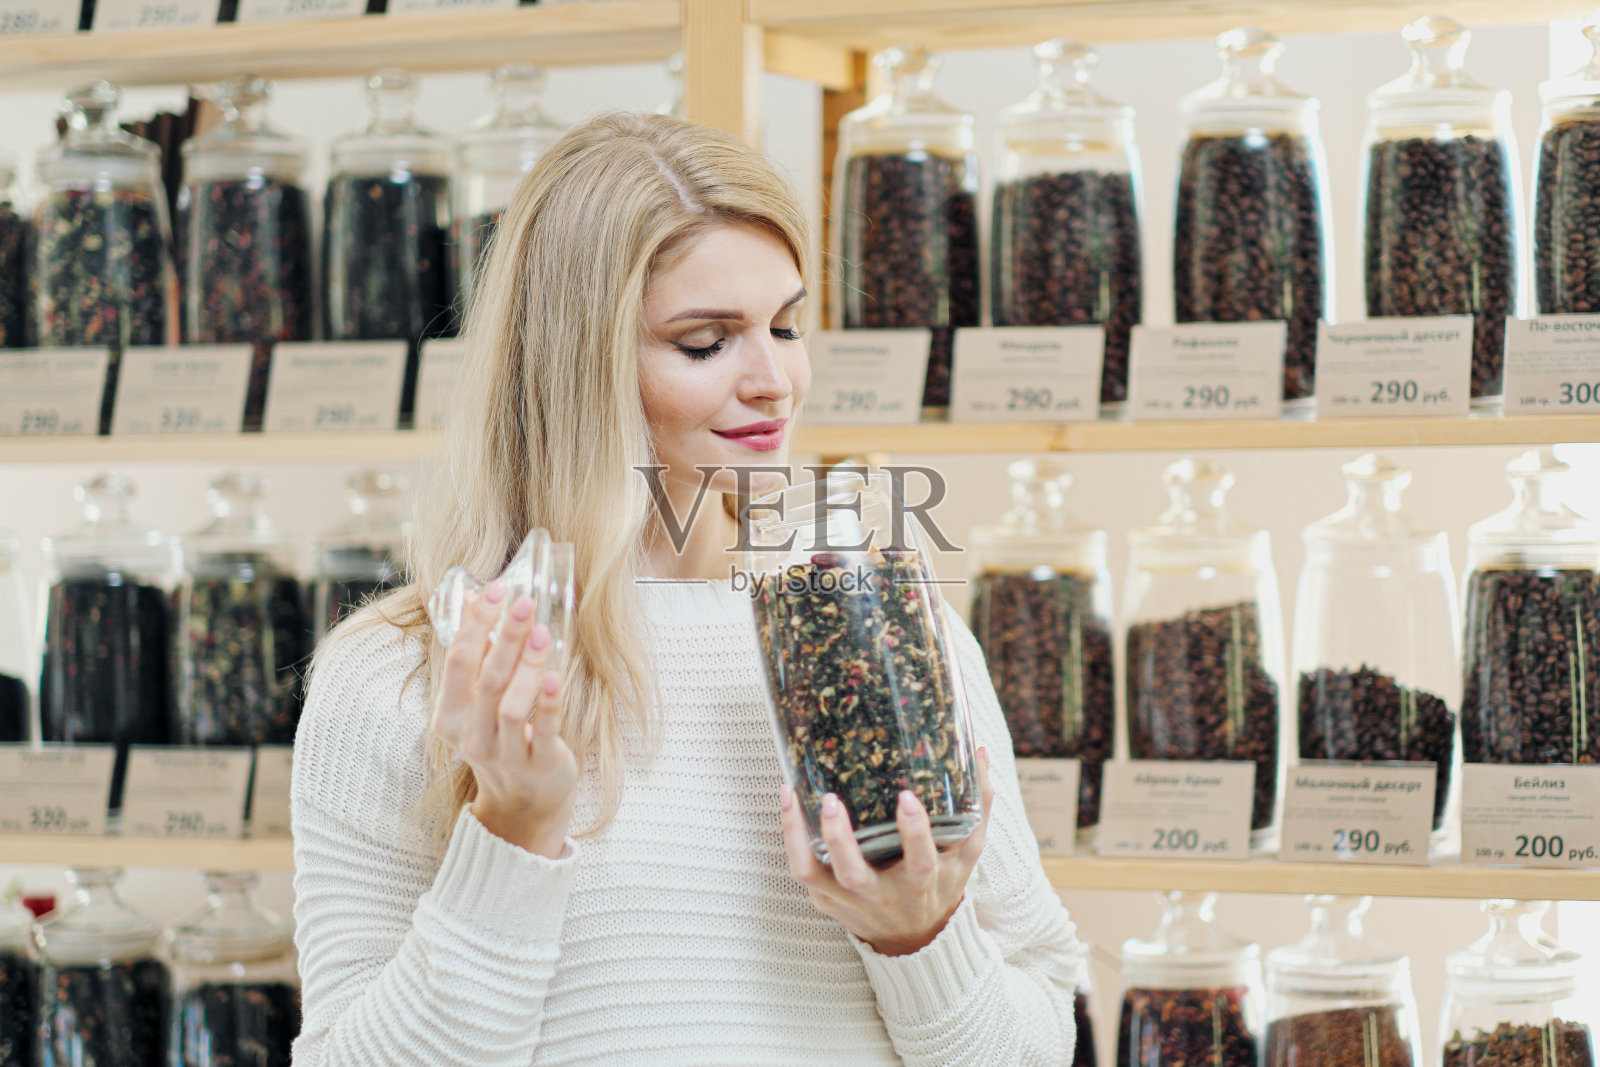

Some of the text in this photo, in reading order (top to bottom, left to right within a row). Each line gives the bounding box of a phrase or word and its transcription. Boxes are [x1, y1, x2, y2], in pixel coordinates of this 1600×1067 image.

[1412, 330, 1460, 343] десерт
[1007, 388, 1052, 410] 290
[1183, 386, 1229, 408] 290
[1370, 380, 1418, 403] 290
[1373, 779, 1422, 792] десерт
[1514, 776, 1566, 790] Бейлиз
[1152, 829, 1199, 850] 200
[1333, 828, 1380, 852] 290
[1515, 835, 1564, 857] 200
[1569, 846, 1600, 862] руб.
